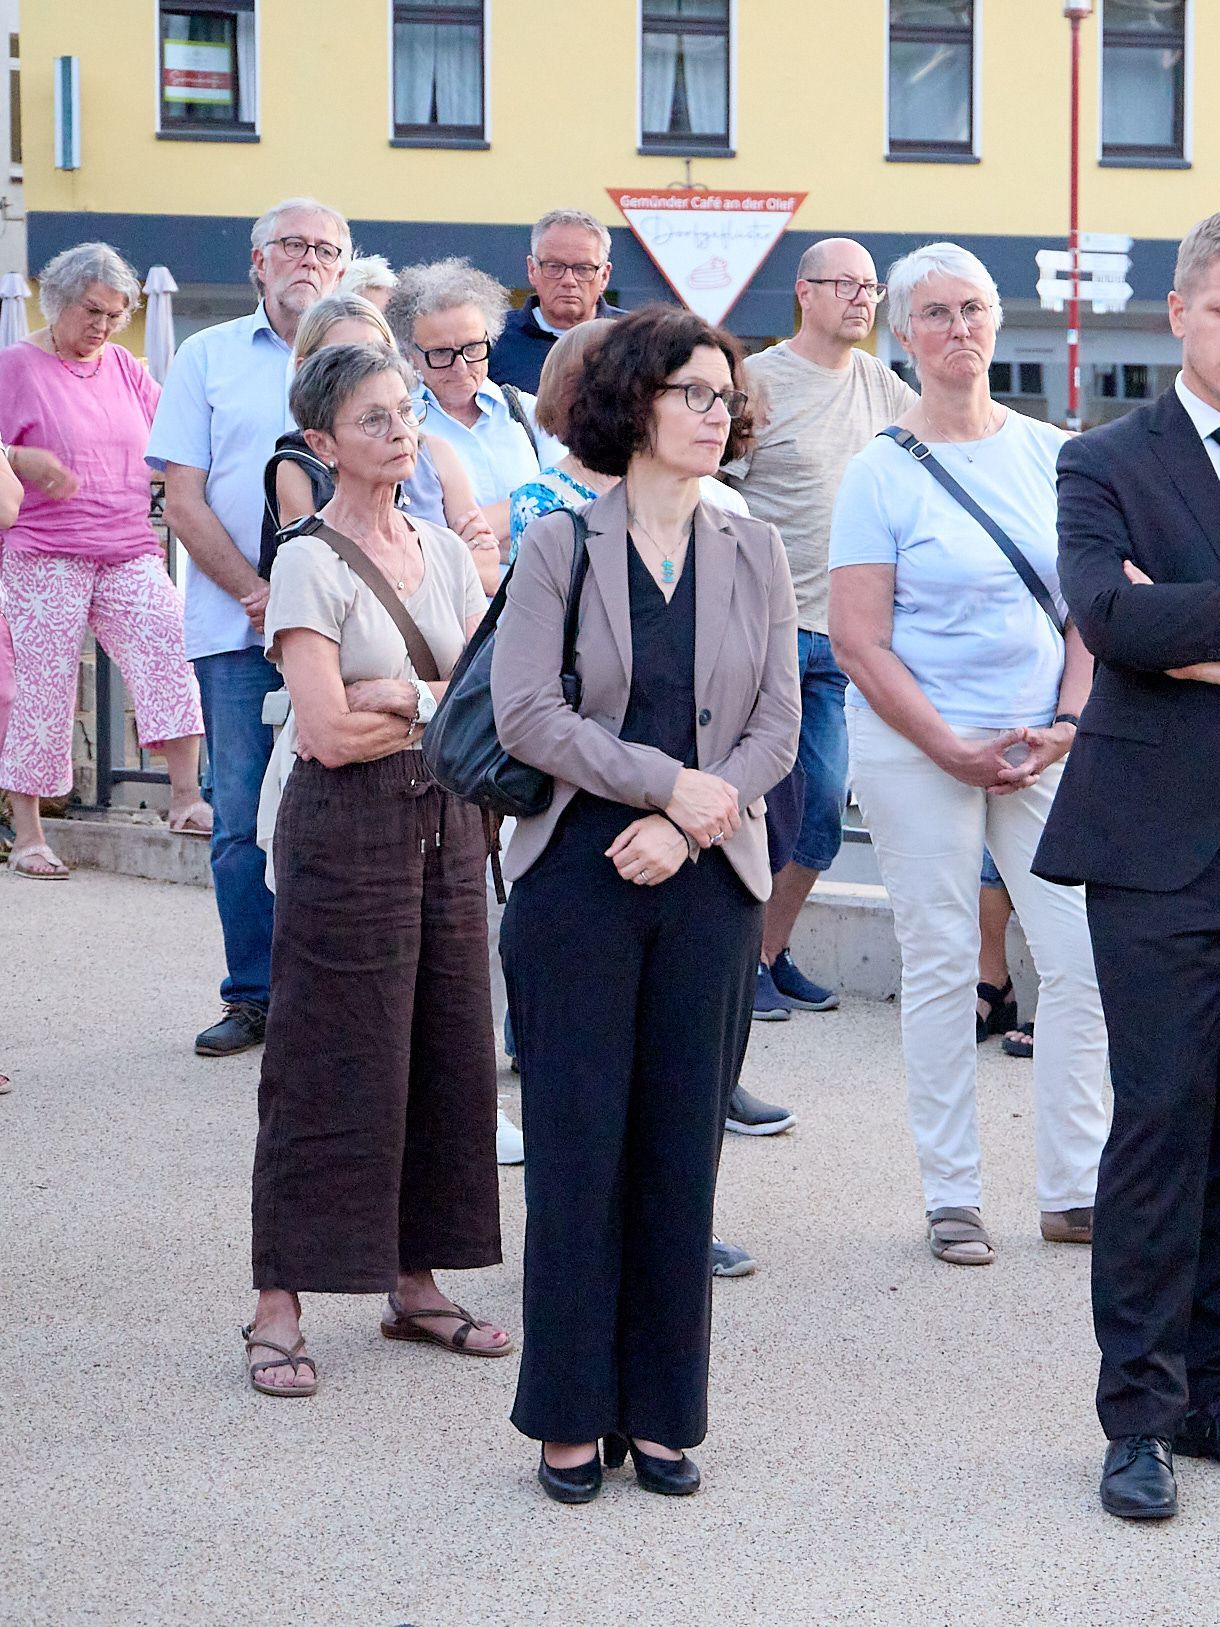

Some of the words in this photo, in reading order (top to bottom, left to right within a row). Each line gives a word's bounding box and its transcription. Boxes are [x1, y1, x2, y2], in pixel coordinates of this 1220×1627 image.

[620, 195, 688, 209] Gemünder
[691, 196, 722, 210] Café
[723, 199, 741, 211] an
[742, 197, 764, 211] der
